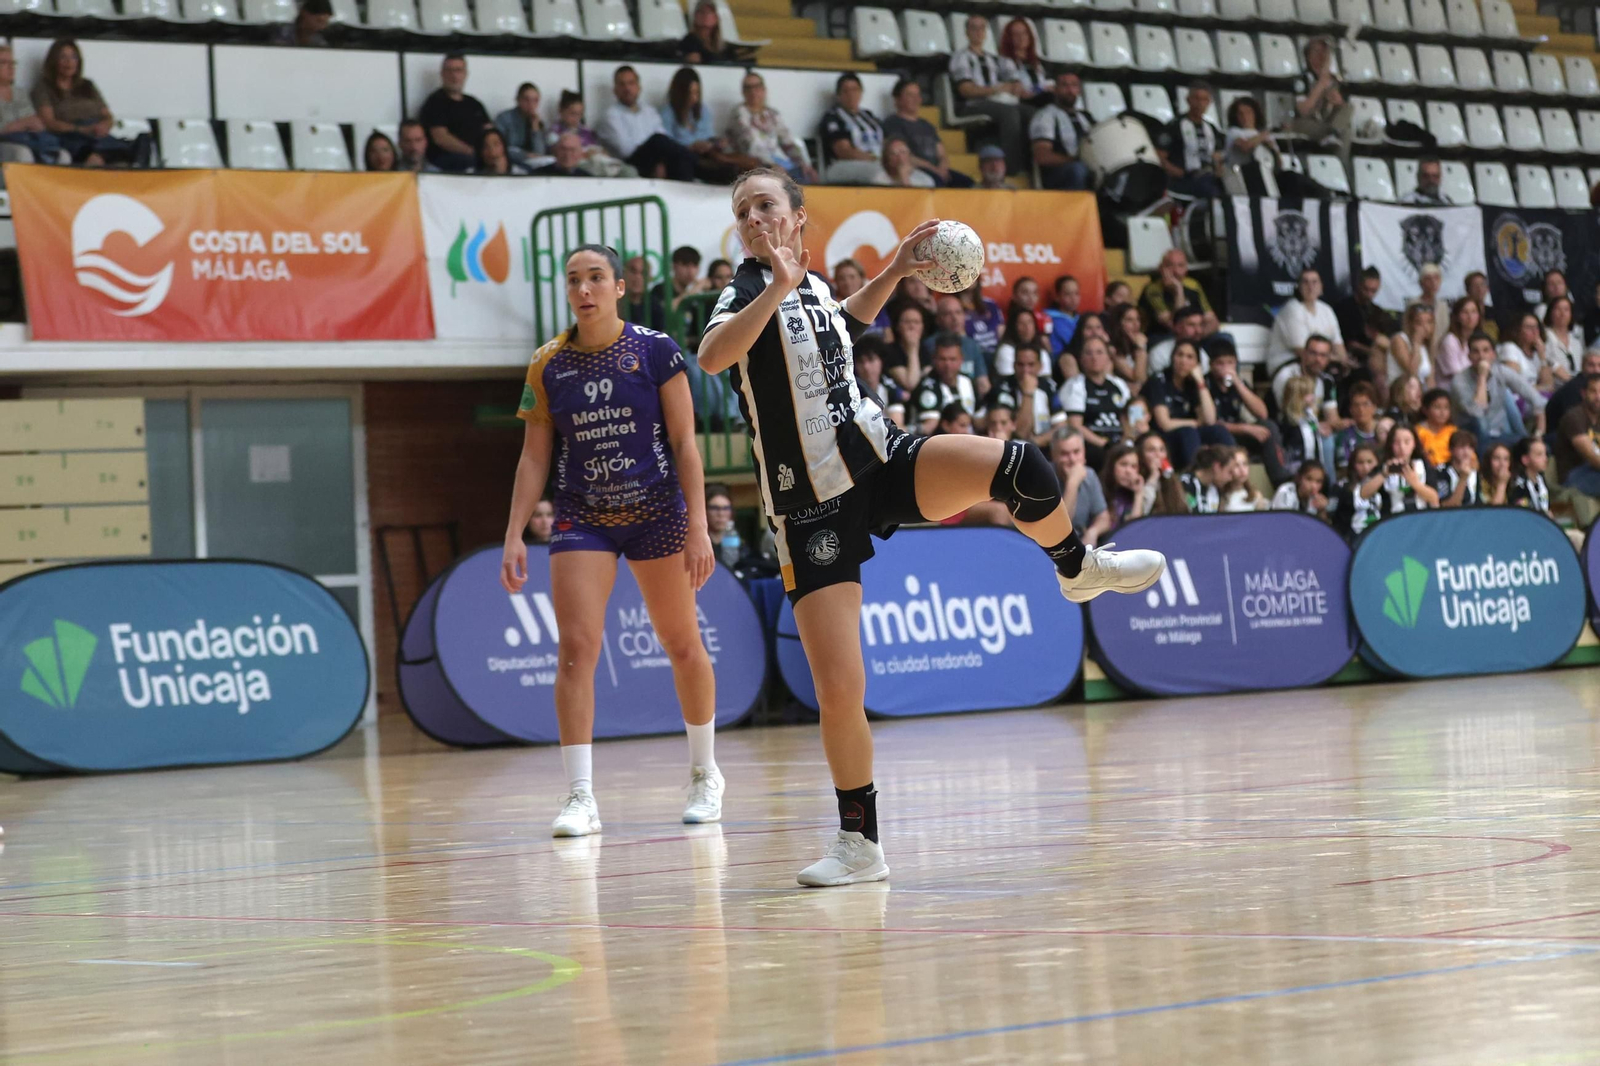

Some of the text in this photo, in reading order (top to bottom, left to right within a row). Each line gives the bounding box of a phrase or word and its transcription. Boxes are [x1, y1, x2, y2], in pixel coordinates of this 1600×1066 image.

[189, 230, 369, 254] COSTA DEL SOL
[988, 242, 1062, 265] DEL SOL
[191, 255, 292, 282] MÁLAGA
[584, 378, 614, 404] 99
[572, 404, 633, 427] Motive
[575, 420, 637, 442] market
[594, 440, 620, 451] .com
[1244, 566, 1321, 594] MÁLAGA
[1434, 549, 1560, 593] Fundación
[1241, 589, 1328, 618] COMPITE
[1440, 588, 1532, 633] Unicaja
[1129, 611, 1223, 631] Diputación Provincial
[108, 613, 320, 665] Fundación
[1155, 629, 1202, 645] de Málaga
[487, 652, 546, 673] Diputación
[871, 649, 983, 676] la ciudad redonda
[117, 661, 272, 715] Unicaja
[520, 672, 535, 687] de
